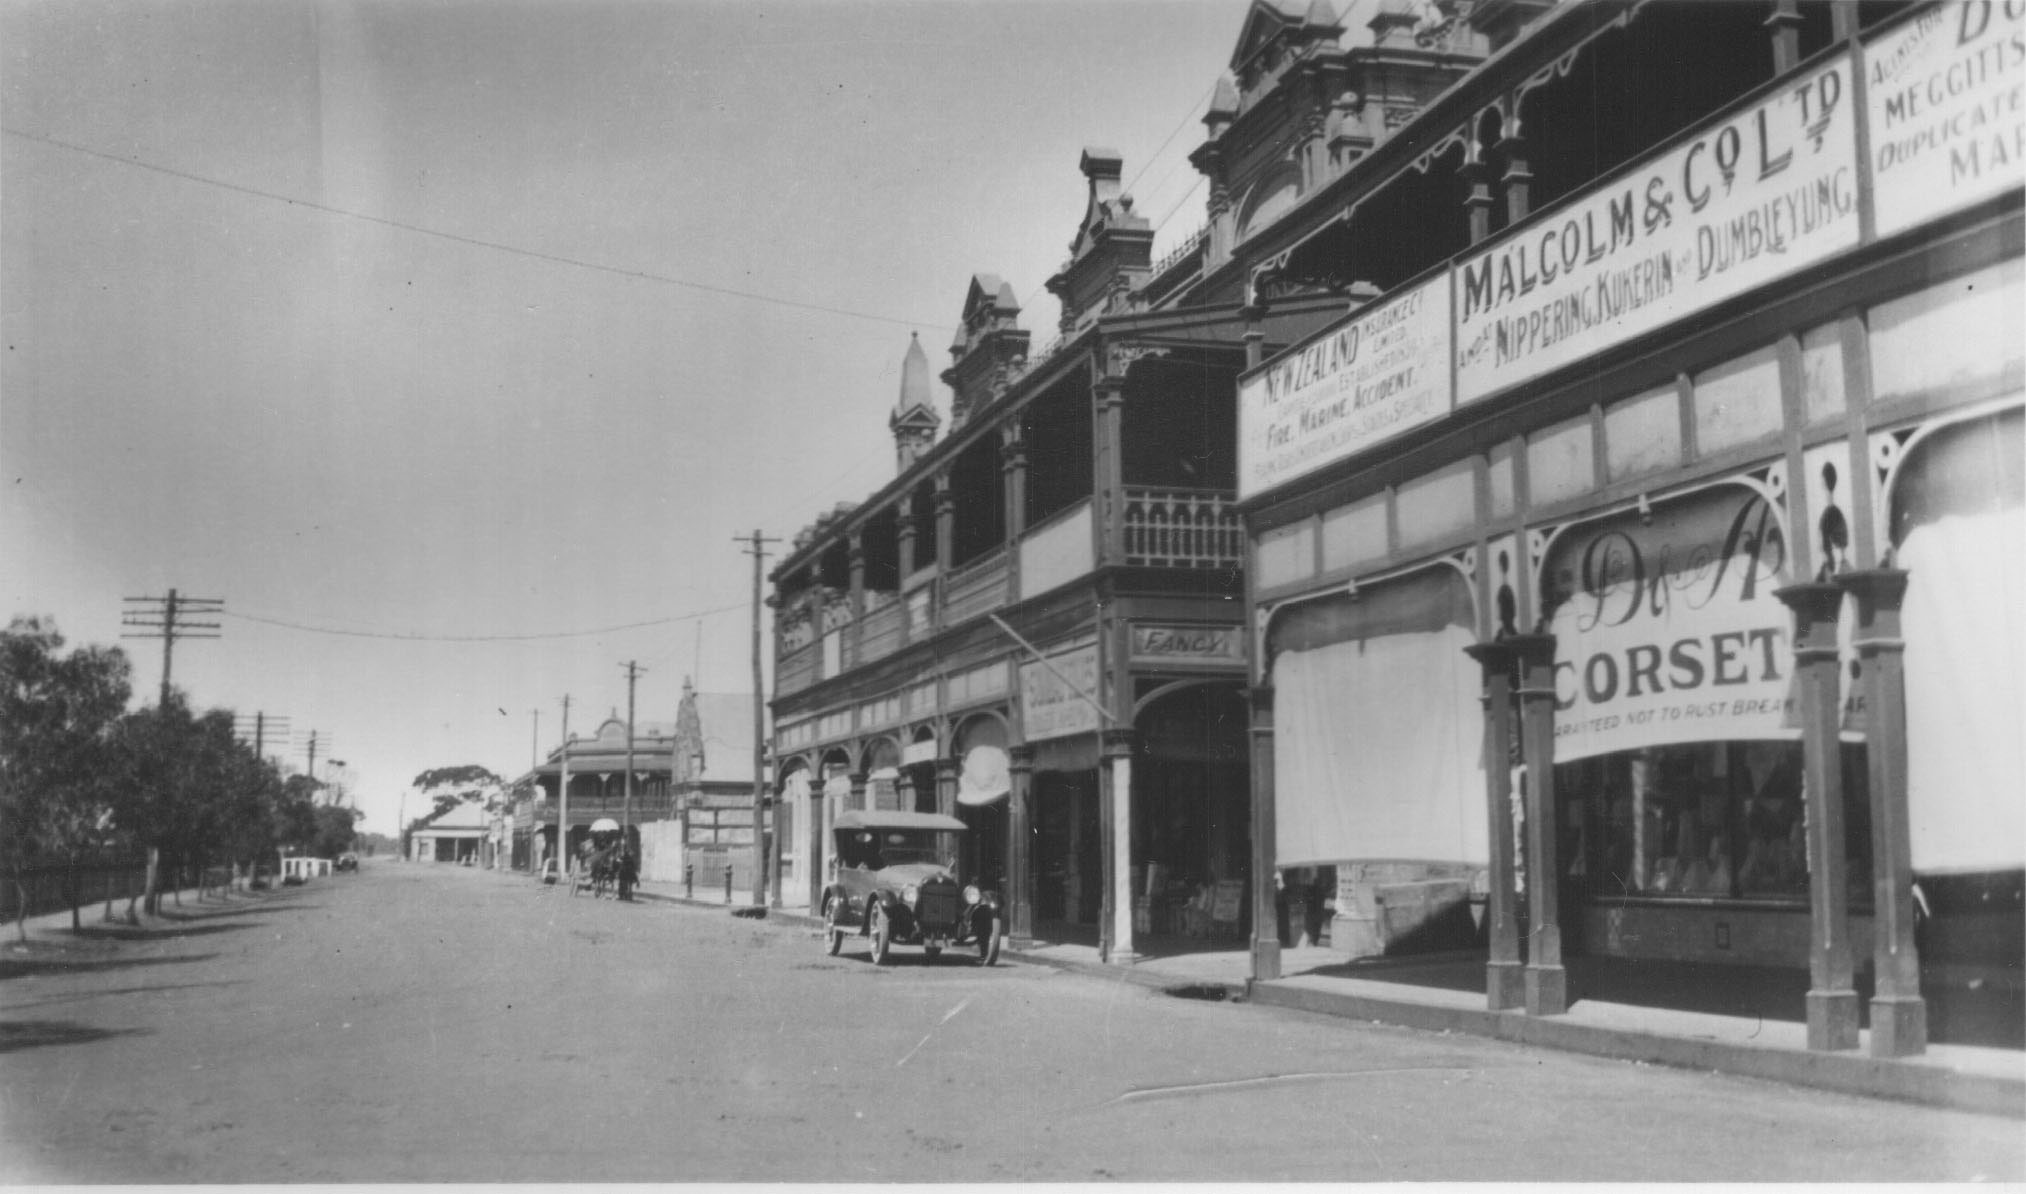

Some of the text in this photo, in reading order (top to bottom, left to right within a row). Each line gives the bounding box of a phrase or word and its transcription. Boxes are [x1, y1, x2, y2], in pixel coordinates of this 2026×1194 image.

[1463, 189, 1635, 323] MALCOLM
[1643, 176, 1674, 236] &
[1263, 357, 1295, 406] NEW
[1295, 324, 1359, 392] ZEALAND
[1554, 627, 1786, 712] CORSET
[1627, 708, 1655, 725] NOT
[1661, 706, 1681, 721] TO
[1684, 700, 1727, 719] RUST
